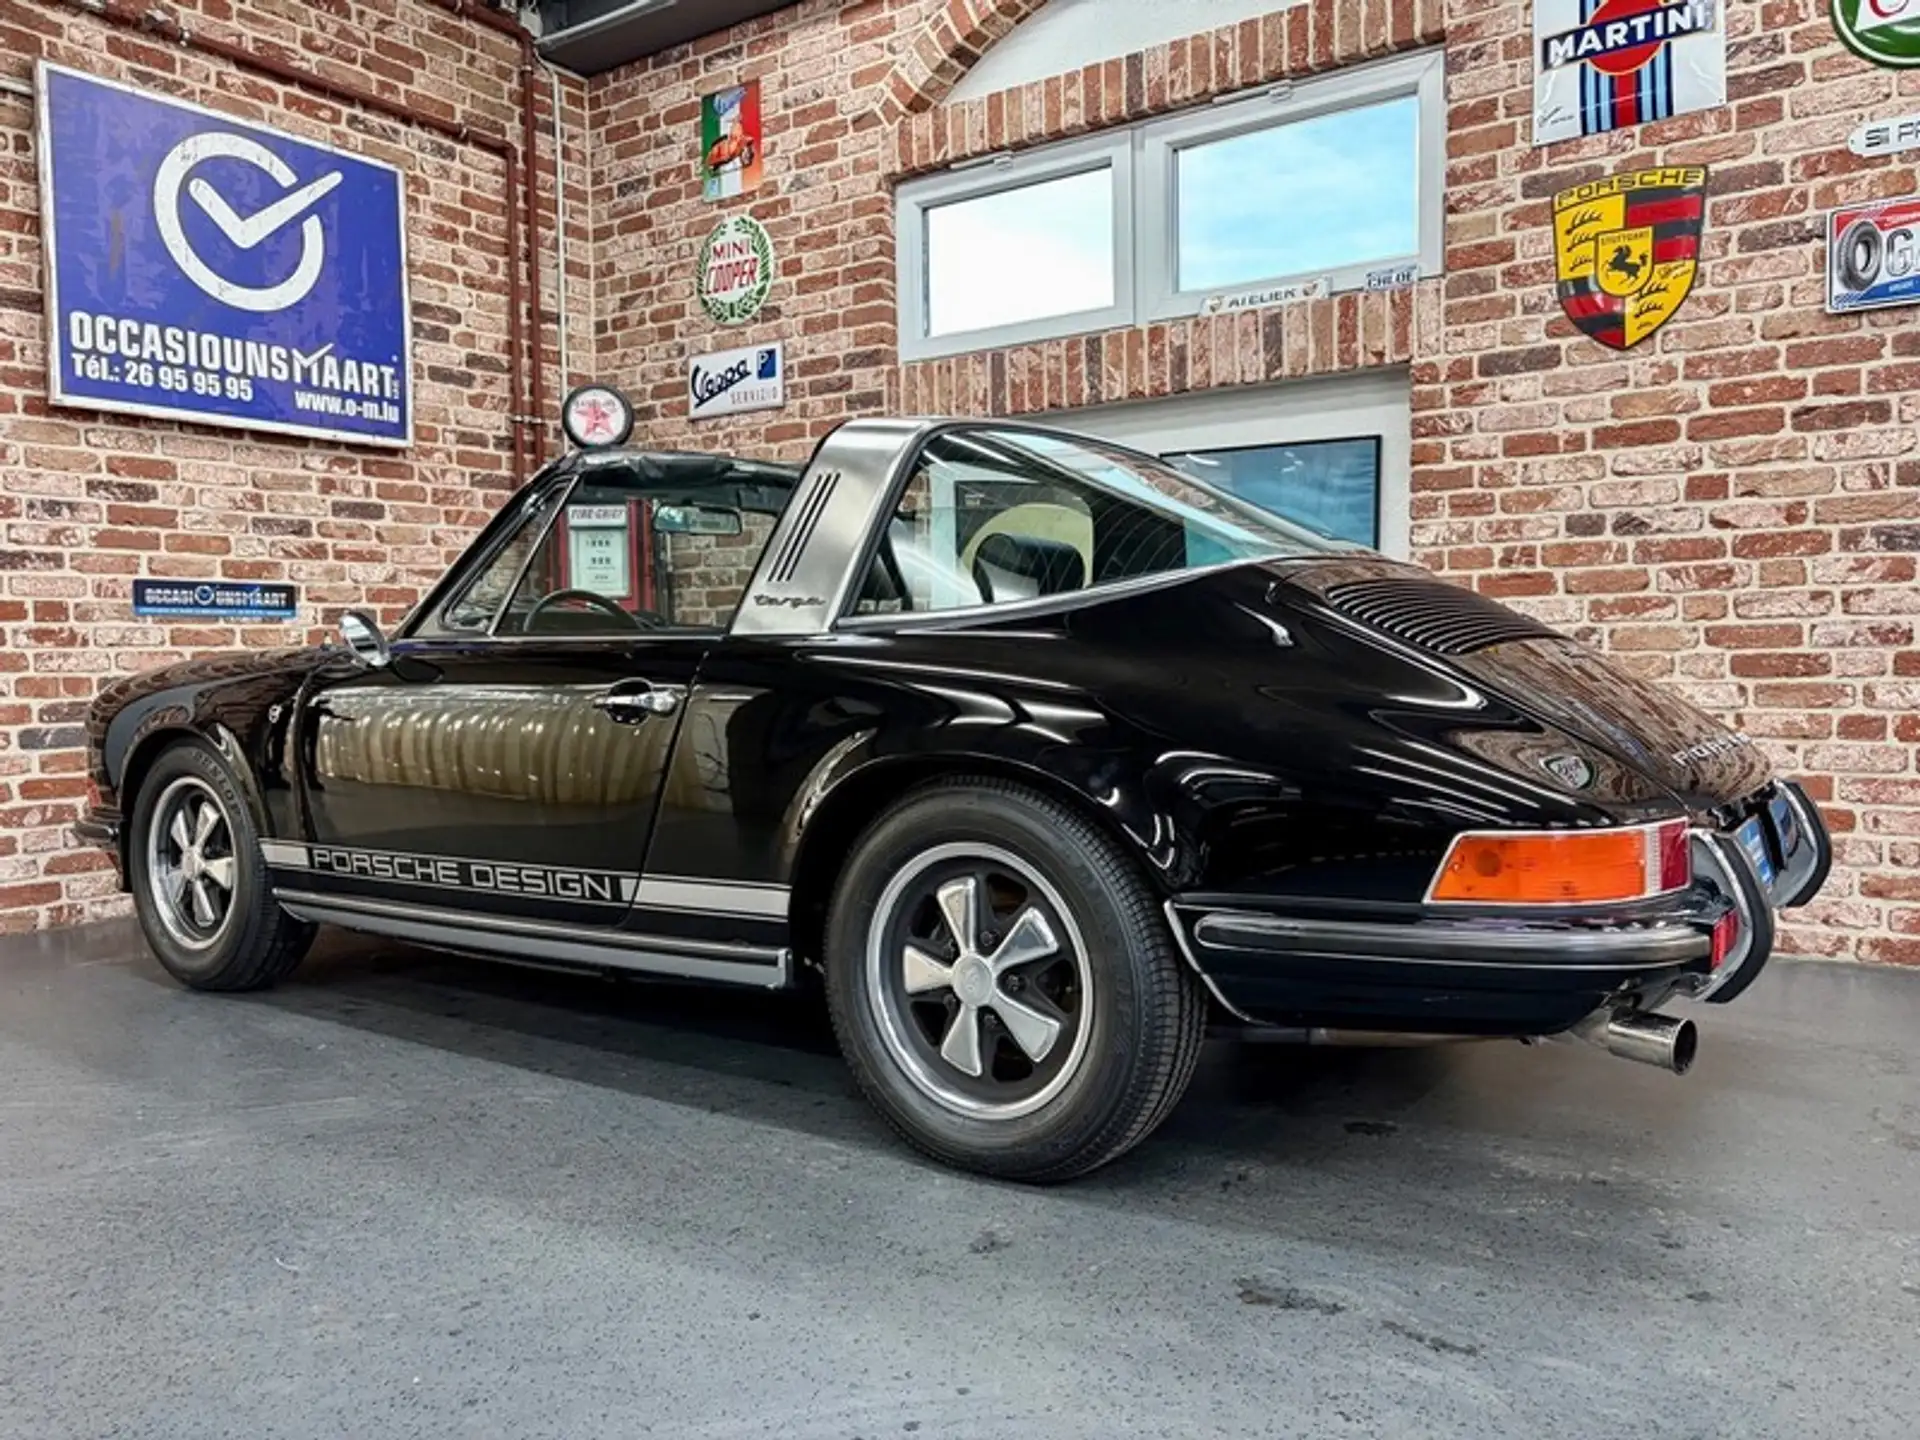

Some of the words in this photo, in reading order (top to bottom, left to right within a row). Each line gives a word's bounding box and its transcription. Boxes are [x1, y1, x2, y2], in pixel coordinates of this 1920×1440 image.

[1549, 2, 1705, 68] MARTINI
[1557, 169, 1702, 208] PORSCHE
[712, 239, 750, 262] MINI
[706, 256, 758, 294] COOPER
[124, 360, 155, 388] 26
[158, 366, 189, 393] 95
[192, 371, 222, 398] 95
[225, 376, 254, 402] 95
[311, 849, 462, 885] PORSCHE
[469, 863, 613, 901] DESIGN
